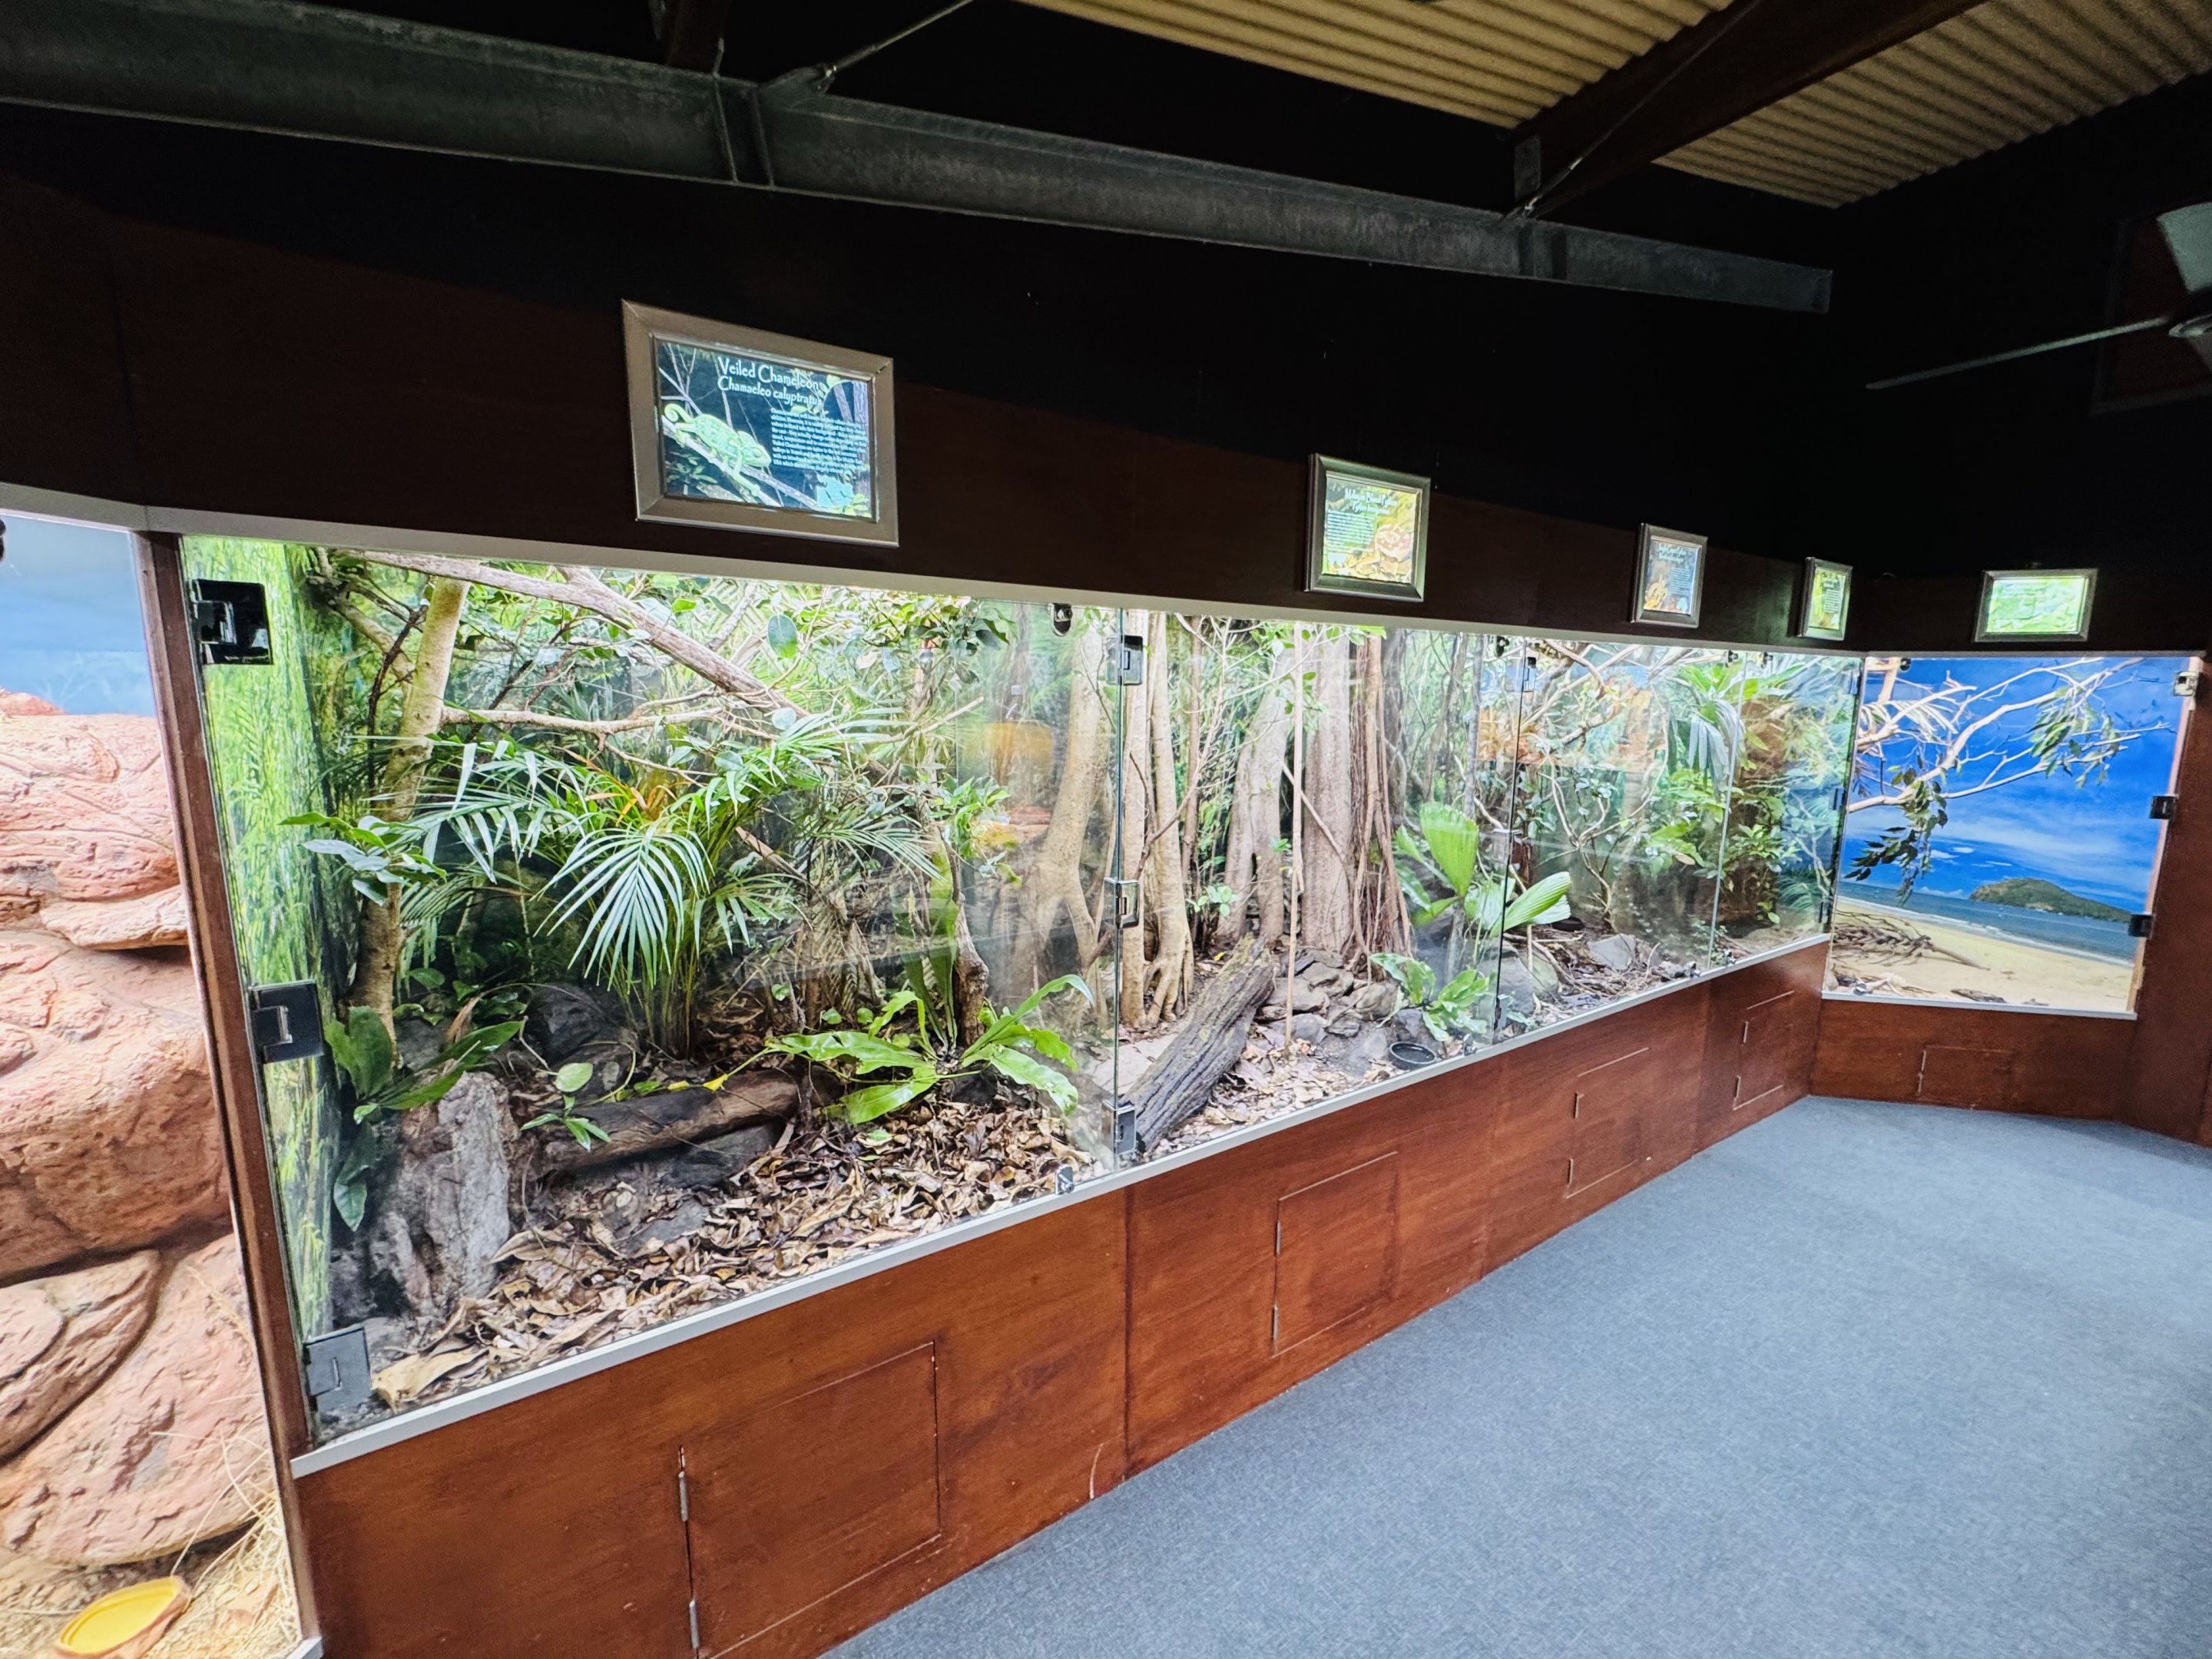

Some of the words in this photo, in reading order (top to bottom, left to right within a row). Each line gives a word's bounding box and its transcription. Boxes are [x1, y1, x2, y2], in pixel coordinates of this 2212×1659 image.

[718, 356, 756, 378] Veiled
[758, 365, 819, 389] Chameleon
[718, 376, 771, 396] Chamaeleo
[773, 387, 823, 406] calyptratus
